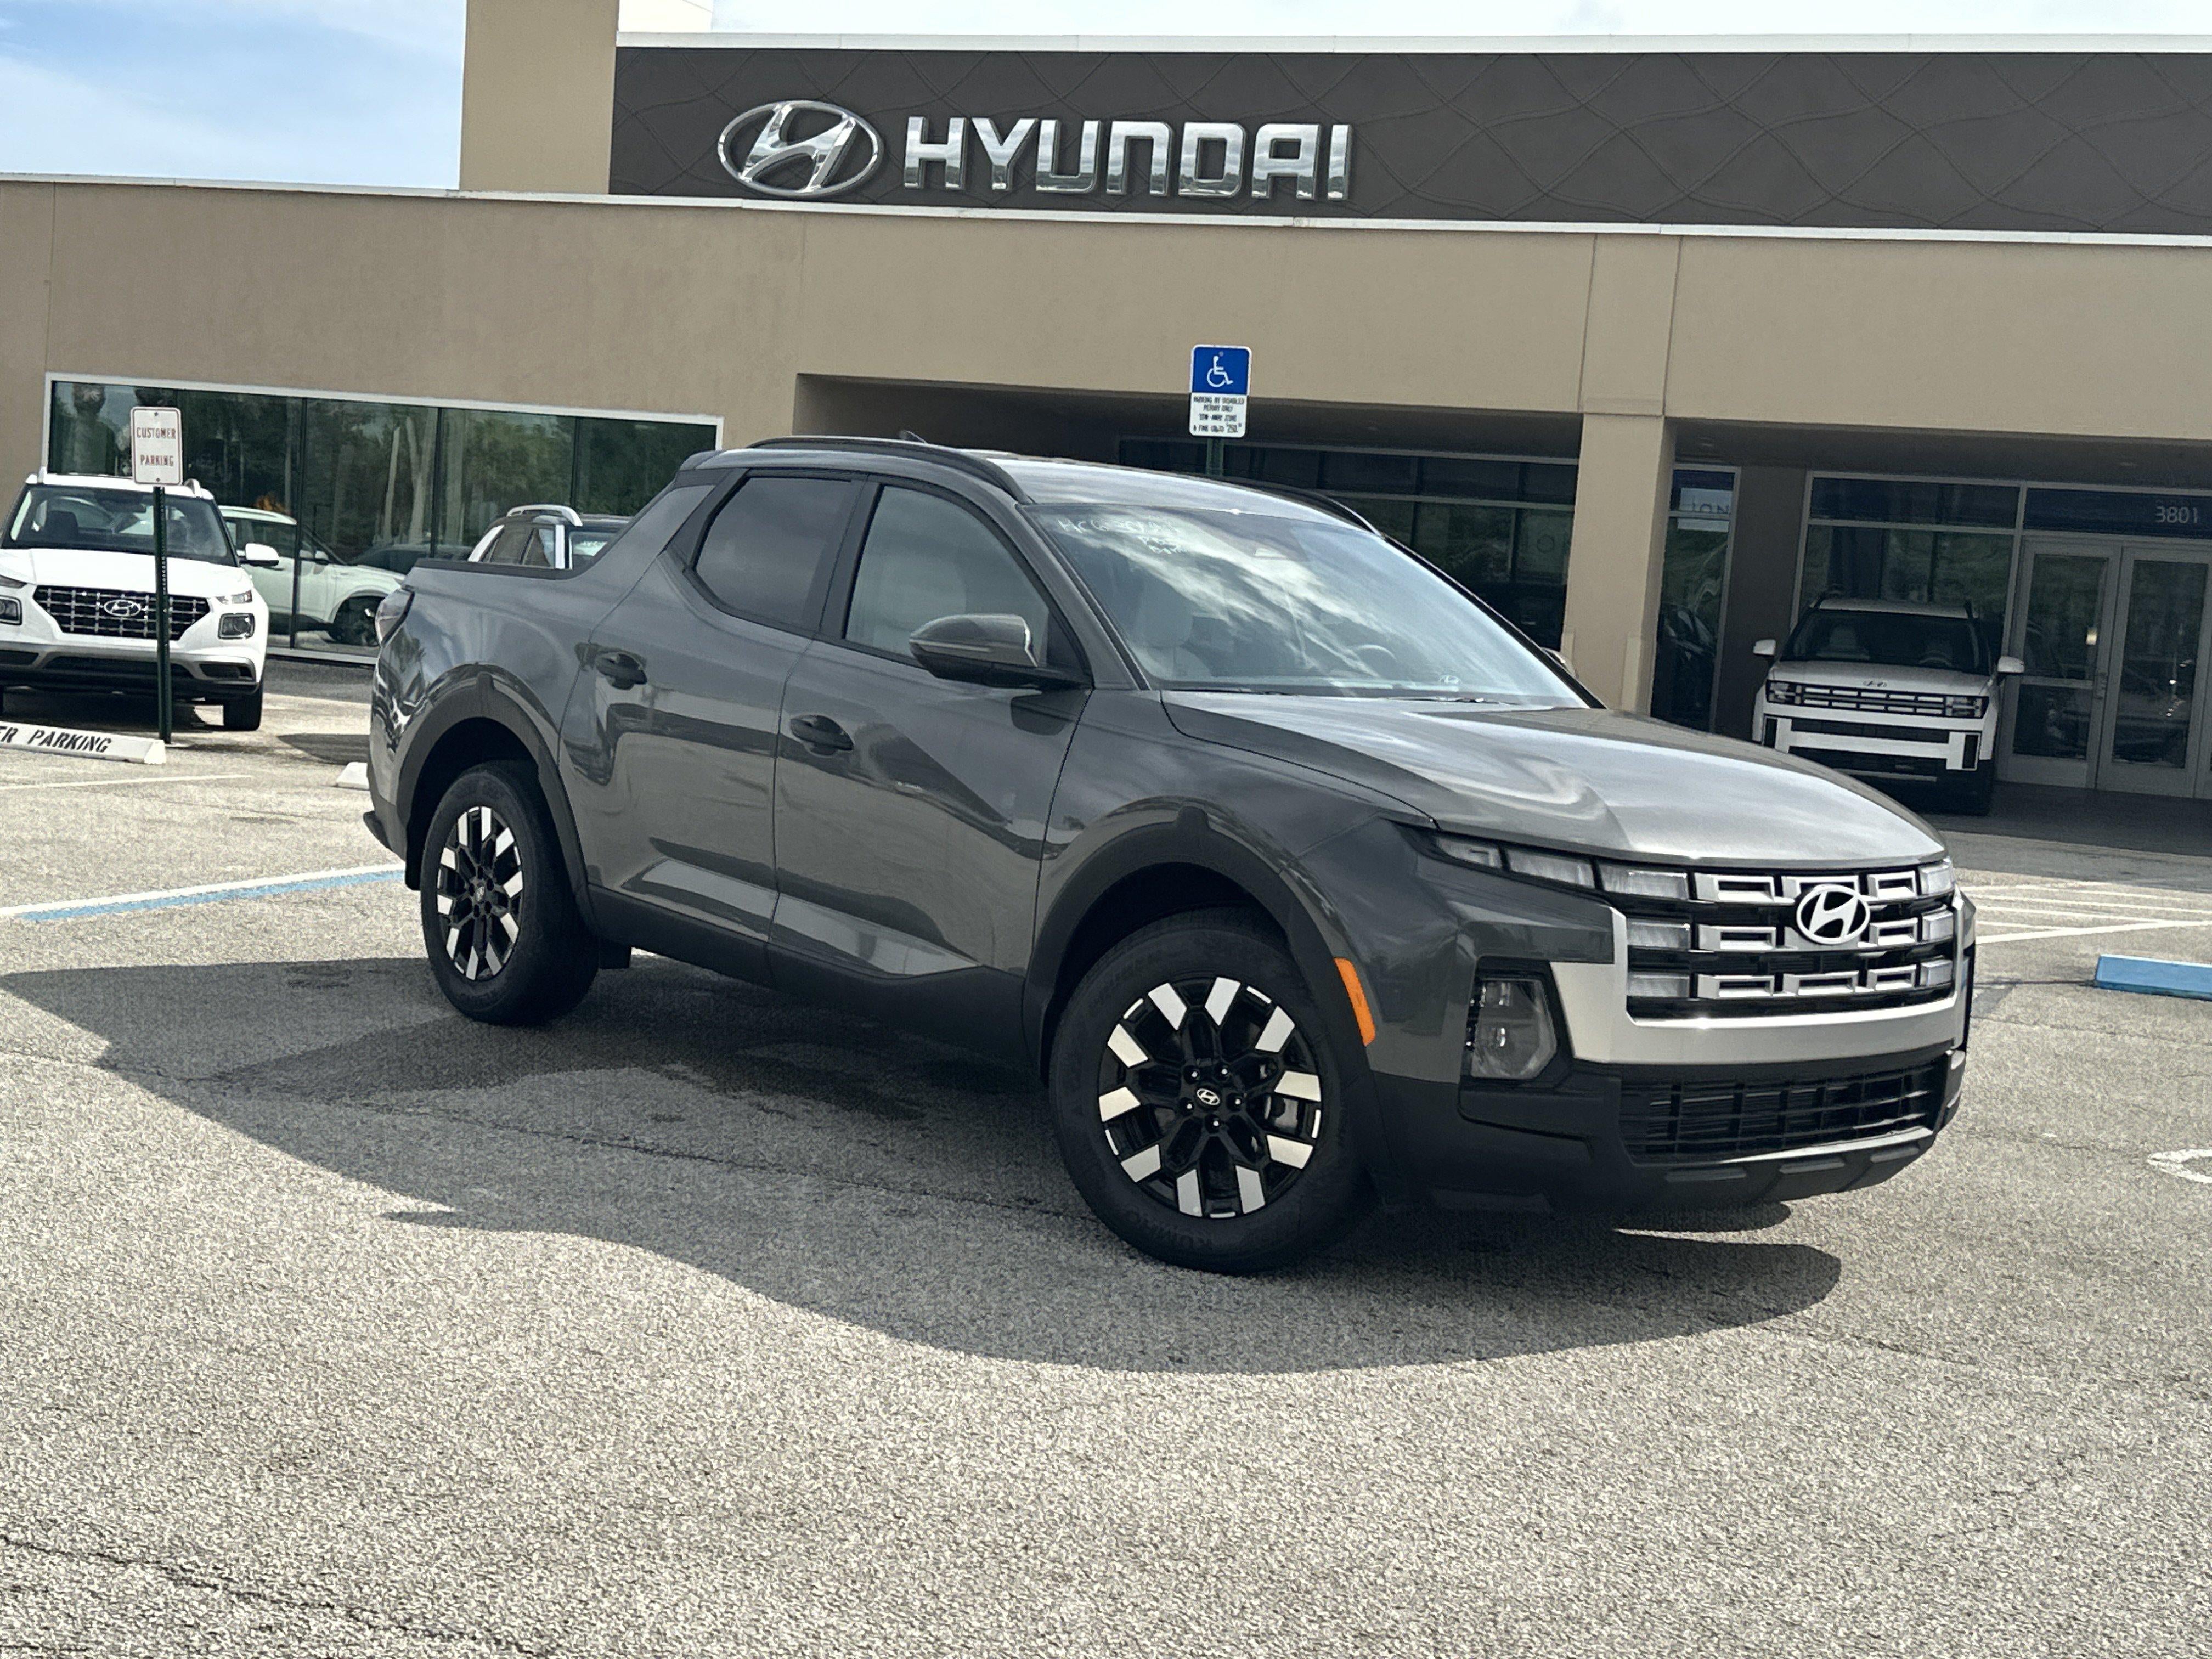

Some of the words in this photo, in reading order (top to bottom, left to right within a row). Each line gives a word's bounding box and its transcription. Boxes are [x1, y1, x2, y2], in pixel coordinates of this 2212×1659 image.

[904, 115, 1352, 202] HYUNDAI
[137, 427, 176, 439] CUSTOMER
[140, 454, 174, 466] PARKING
[2155, 506, 2198, 524] 3801
[27, 729, 112, 753] PARKING
